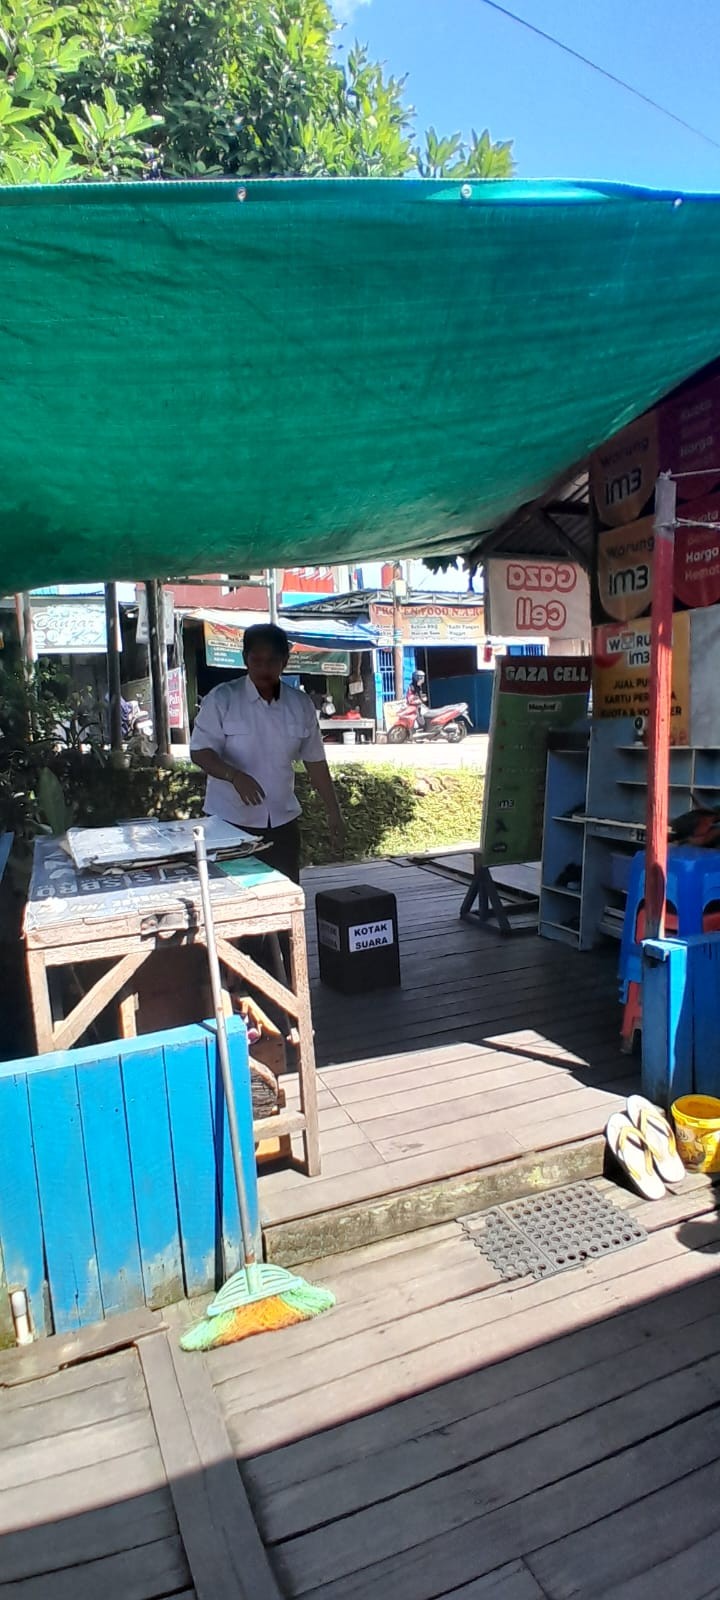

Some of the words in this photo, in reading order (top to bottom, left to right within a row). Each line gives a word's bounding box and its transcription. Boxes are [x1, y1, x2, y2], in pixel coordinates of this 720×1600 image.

[605, 536, 655, 559] Warung
[609, 564, 649, 597] im3
[505, 666, 548, 681] GAZA
[553, 666, 588, 681] CELL
[354, 923, 388, 937] KOTAK
[355, 936, 388, 950] SUARA
